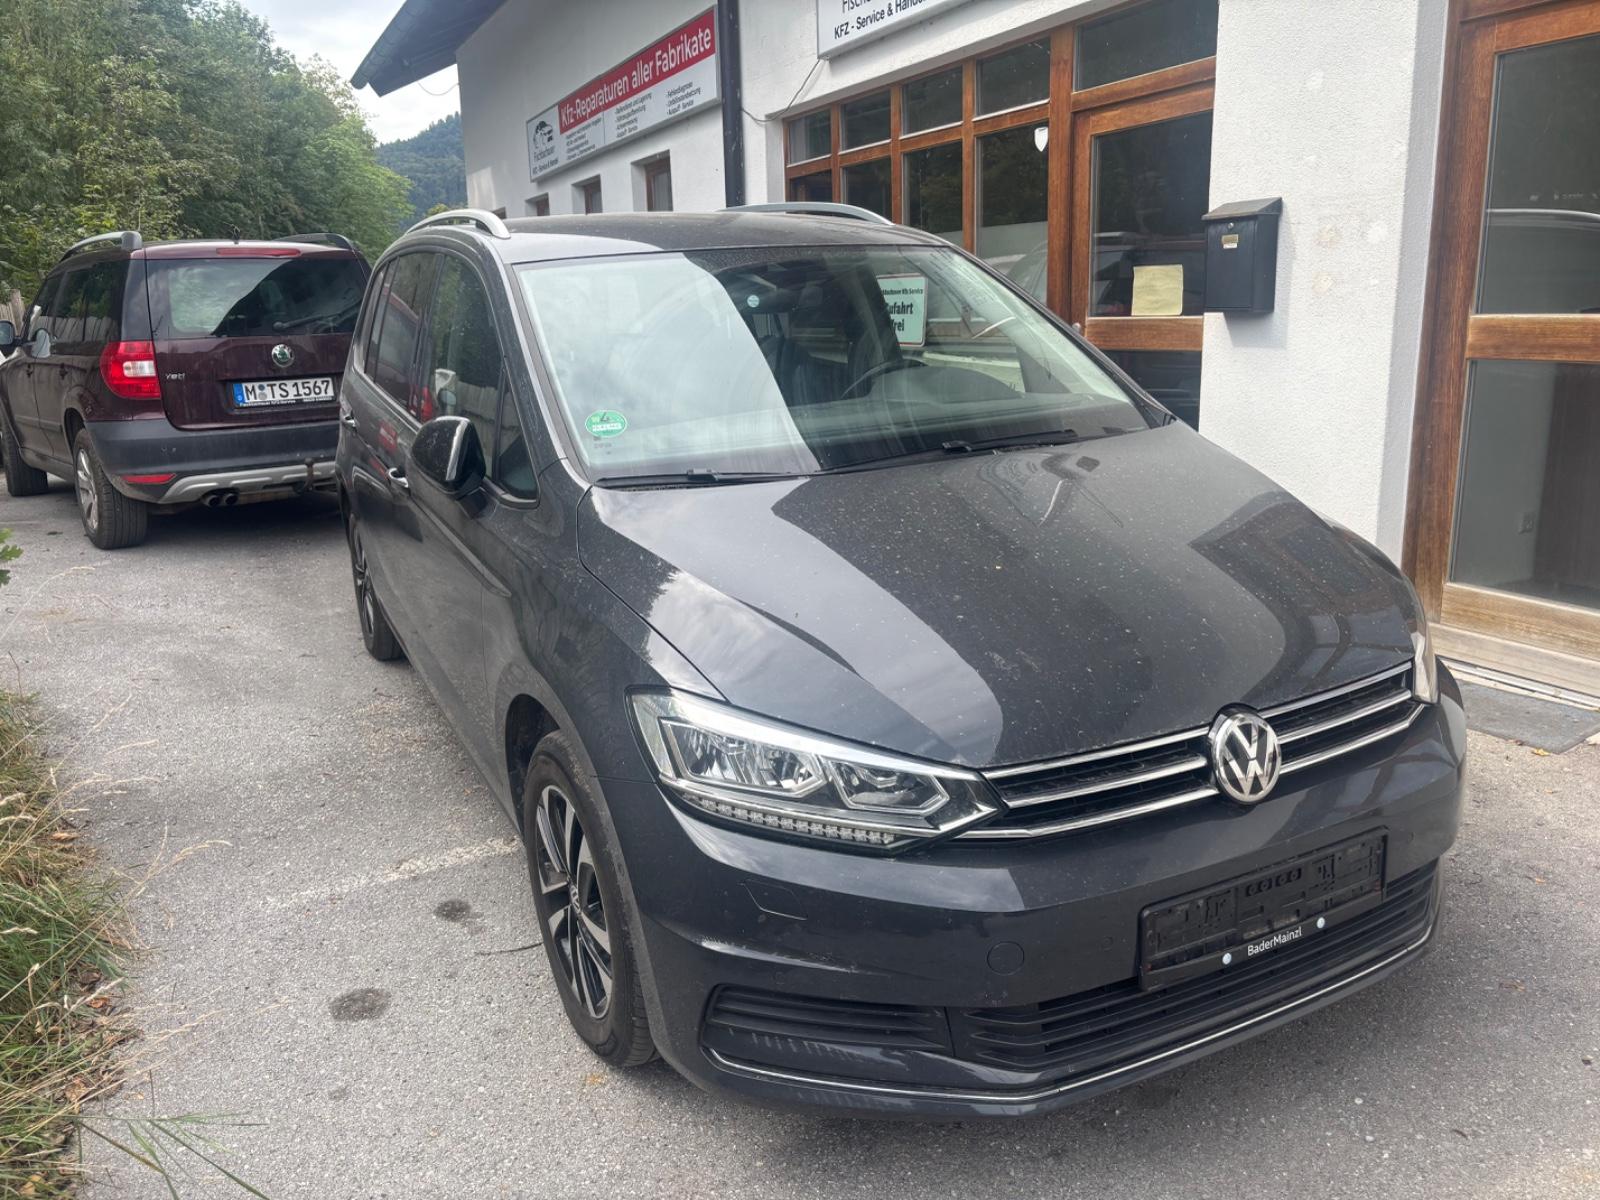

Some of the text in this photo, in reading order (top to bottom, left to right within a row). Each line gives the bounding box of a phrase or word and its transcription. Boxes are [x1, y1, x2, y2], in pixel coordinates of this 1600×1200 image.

[834, 22, 850, 39] KFZ
[856, 9, 885, 30] Service
[887, 3, 894, 17] &
[560, 75, 630, 128] Kfz-Reparaturen
[632, 60, 655, 89] aller
[655, 27, 712, 77] Fabrikate
[292, 380, 330, 398] 1567
